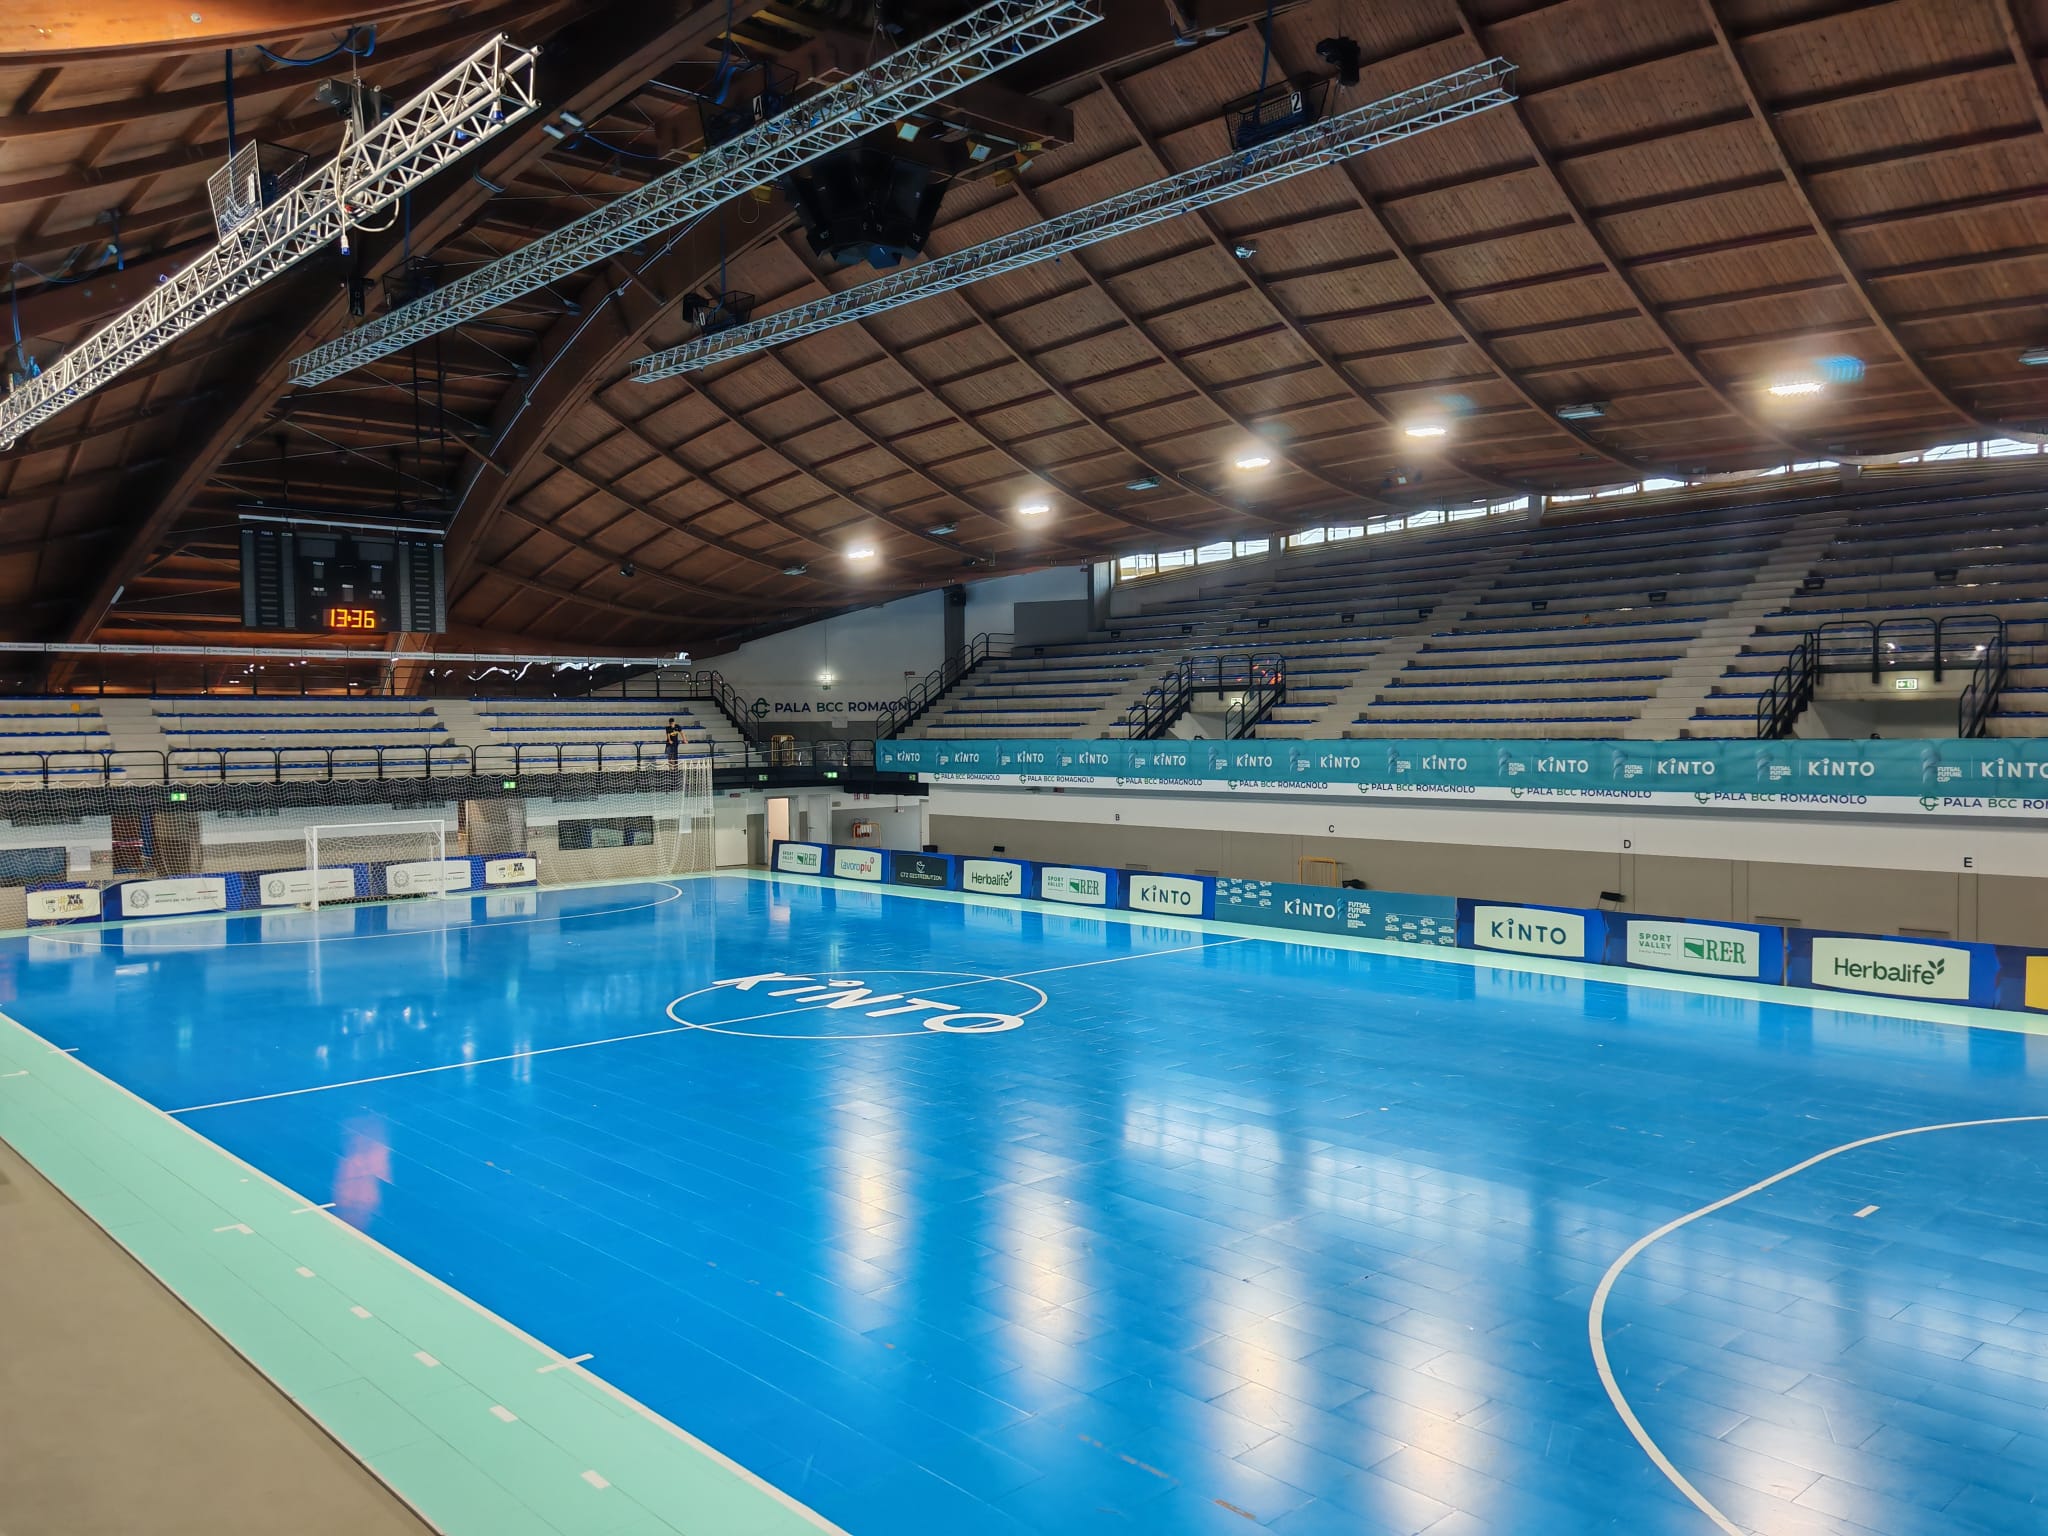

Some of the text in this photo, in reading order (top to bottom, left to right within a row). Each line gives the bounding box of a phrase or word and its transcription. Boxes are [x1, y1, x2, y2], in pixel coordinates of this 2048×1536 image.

[1291, 92, 1301, 112] 2
[330, 608, 375, 629] 13:36
[774, 702, 811, 713] PALA
[816, 702, 843, 712] BCC
[1278, 781, 1328, 789] ROMAGNOLO
[1371, 783, 1475, 793] PALA BCC ROMAGNOLO
[1527, 788, 1652, 798] PALA BCC ROMAGNOLO
[1714, 792, 1867, 804] PALA BCC ROMAGNOLO
[1943, 797, 2048, 810] PALA BCC RO
[1328, 824, 1335, 833] C
[1623, 839, 1632, 849] D
[1963, 857, 1973, 868] E
[971, 872, 1009, 888] Herbalife
[1348, 907, 1371, 915] FUTURE
[1639, 932, 1672, 942] SPORT
[1639, 940, 1672, 950] VALLEY
[1834, 957, 1935, 985] Herbalife
